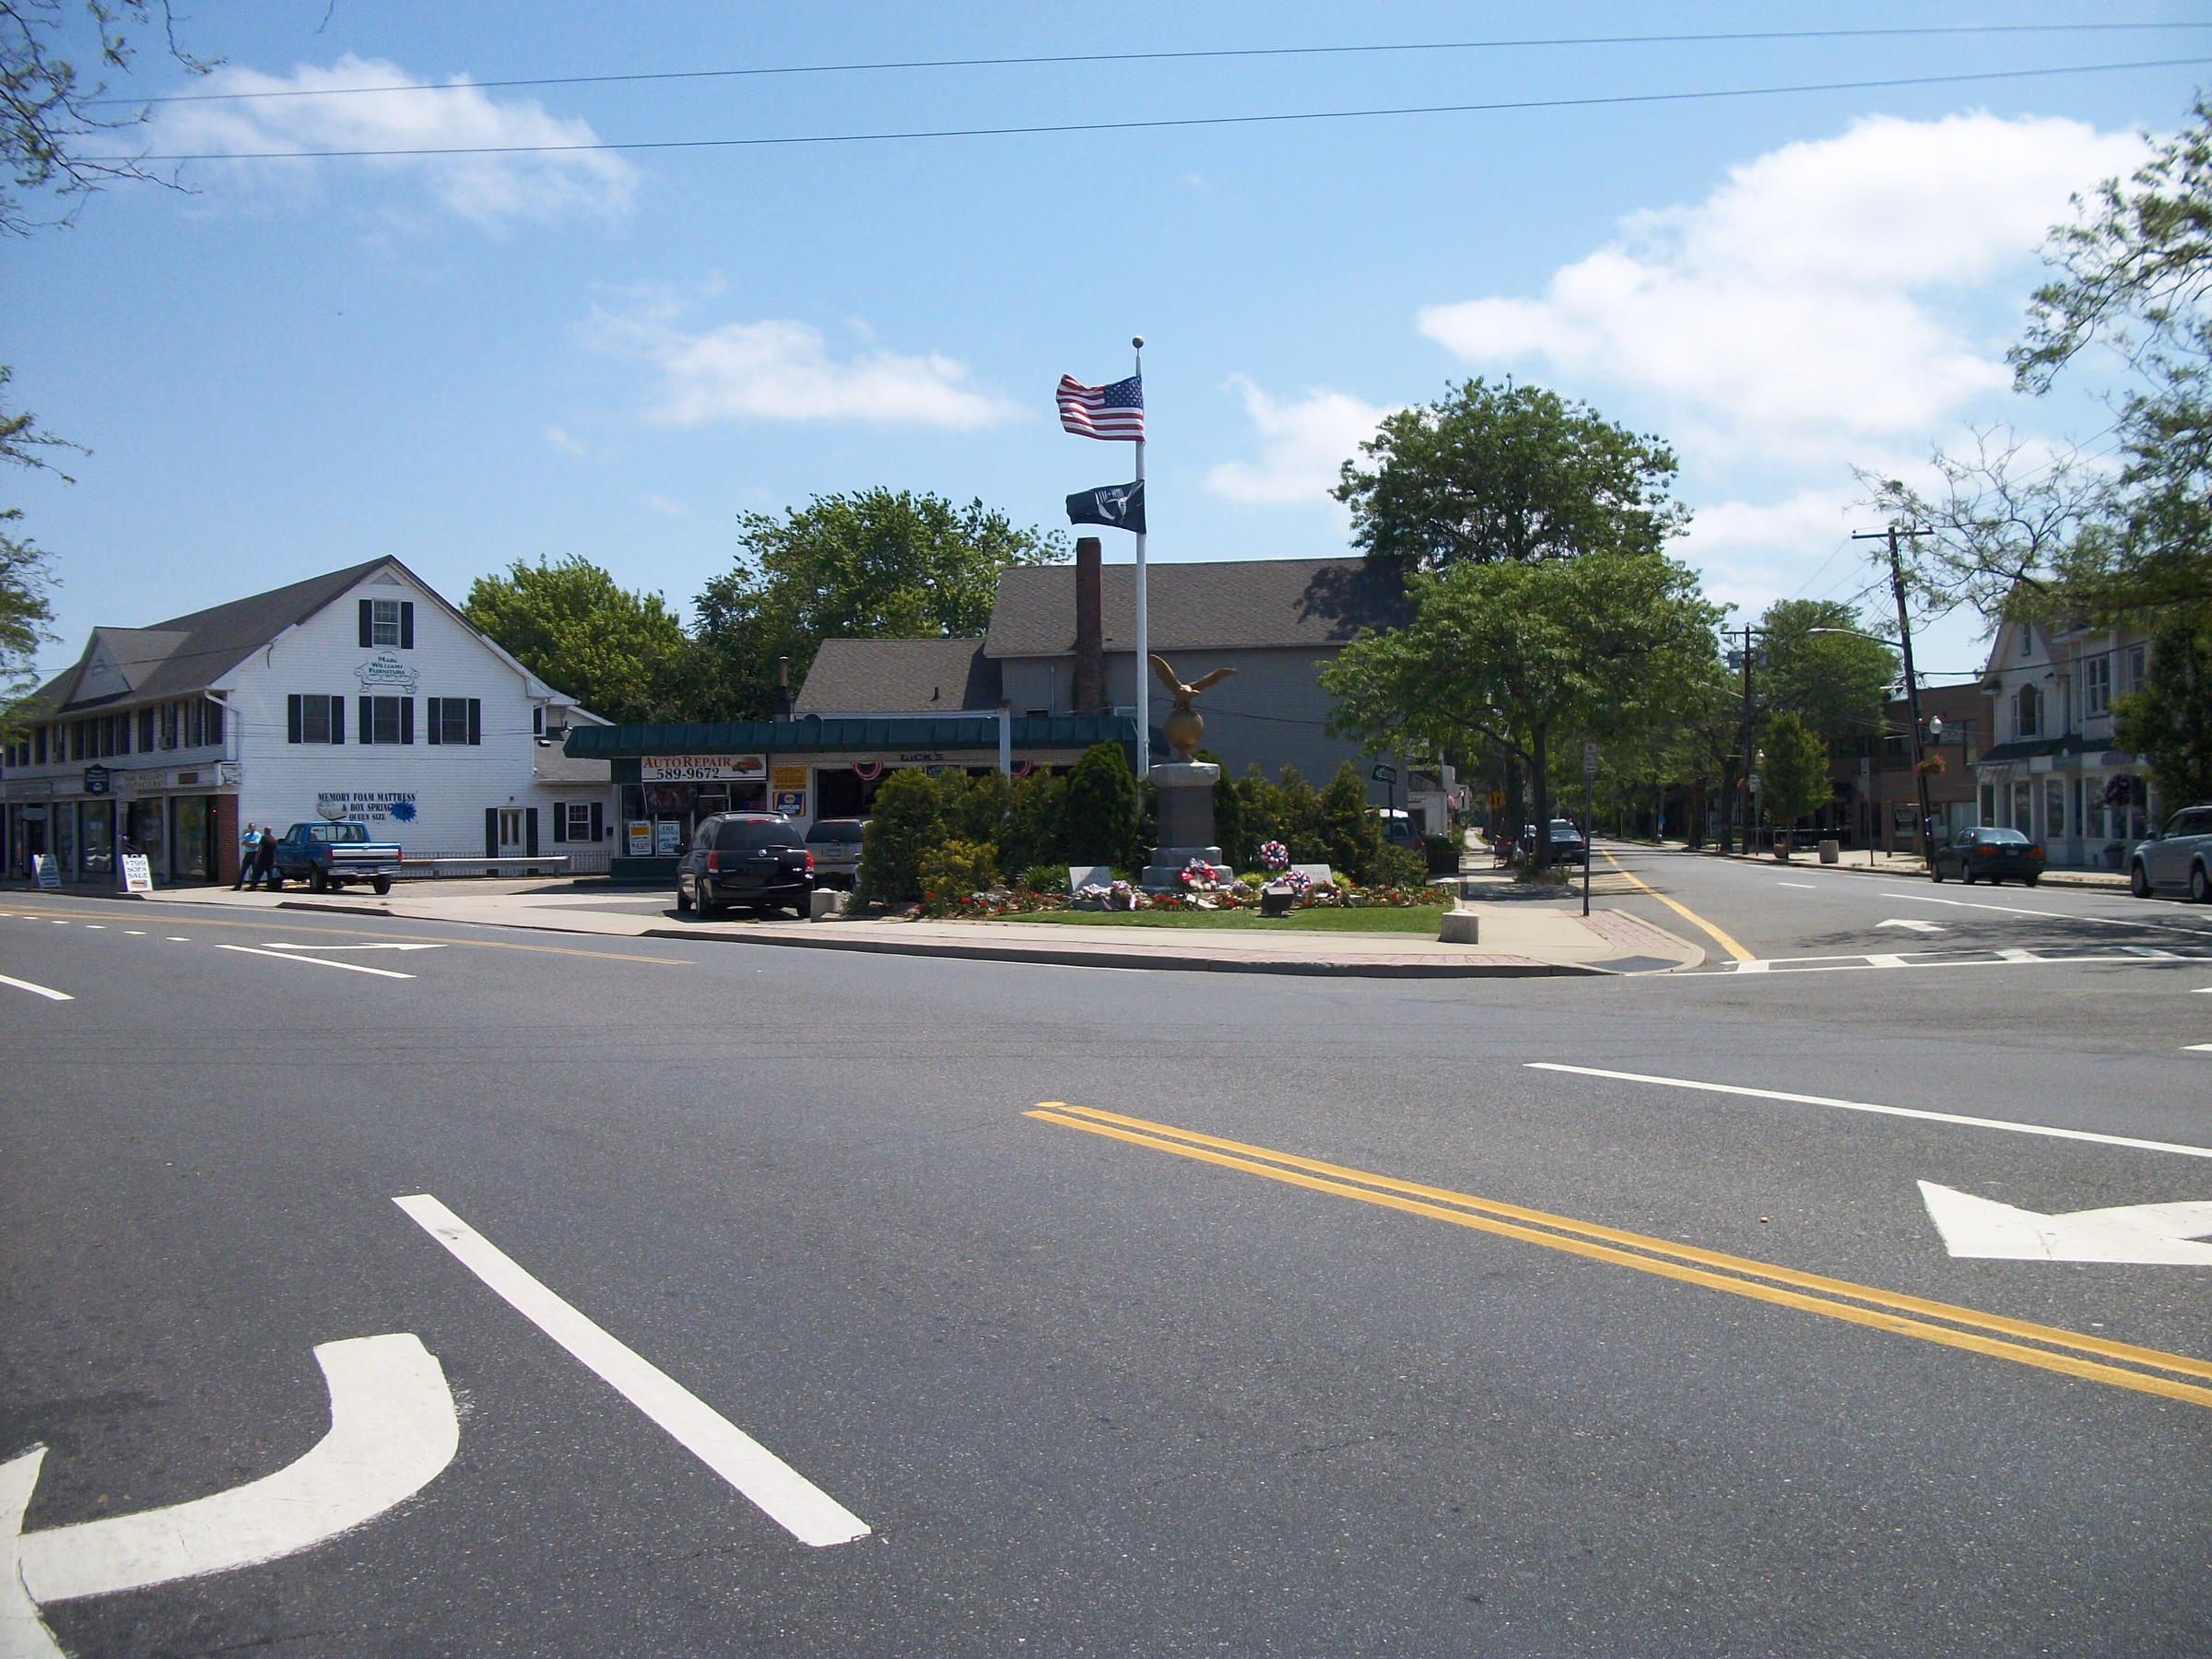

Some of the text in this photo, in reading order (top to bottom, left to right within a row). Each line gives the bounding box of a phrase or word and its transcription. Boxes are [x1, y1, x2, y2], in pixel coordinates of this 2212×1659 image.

[900, 751, 944, 762] DICK'S
[656, 767, 720, 780] 589-9672
[318, 793, 416, 802] MEMORY FOAM MATTRESS
[341, 803, 347, 812] &
[350, 803, 366, 812] BOX
[367, 803, 393, 812] SPRING
[349, 813, 370, 821] QUEEN
